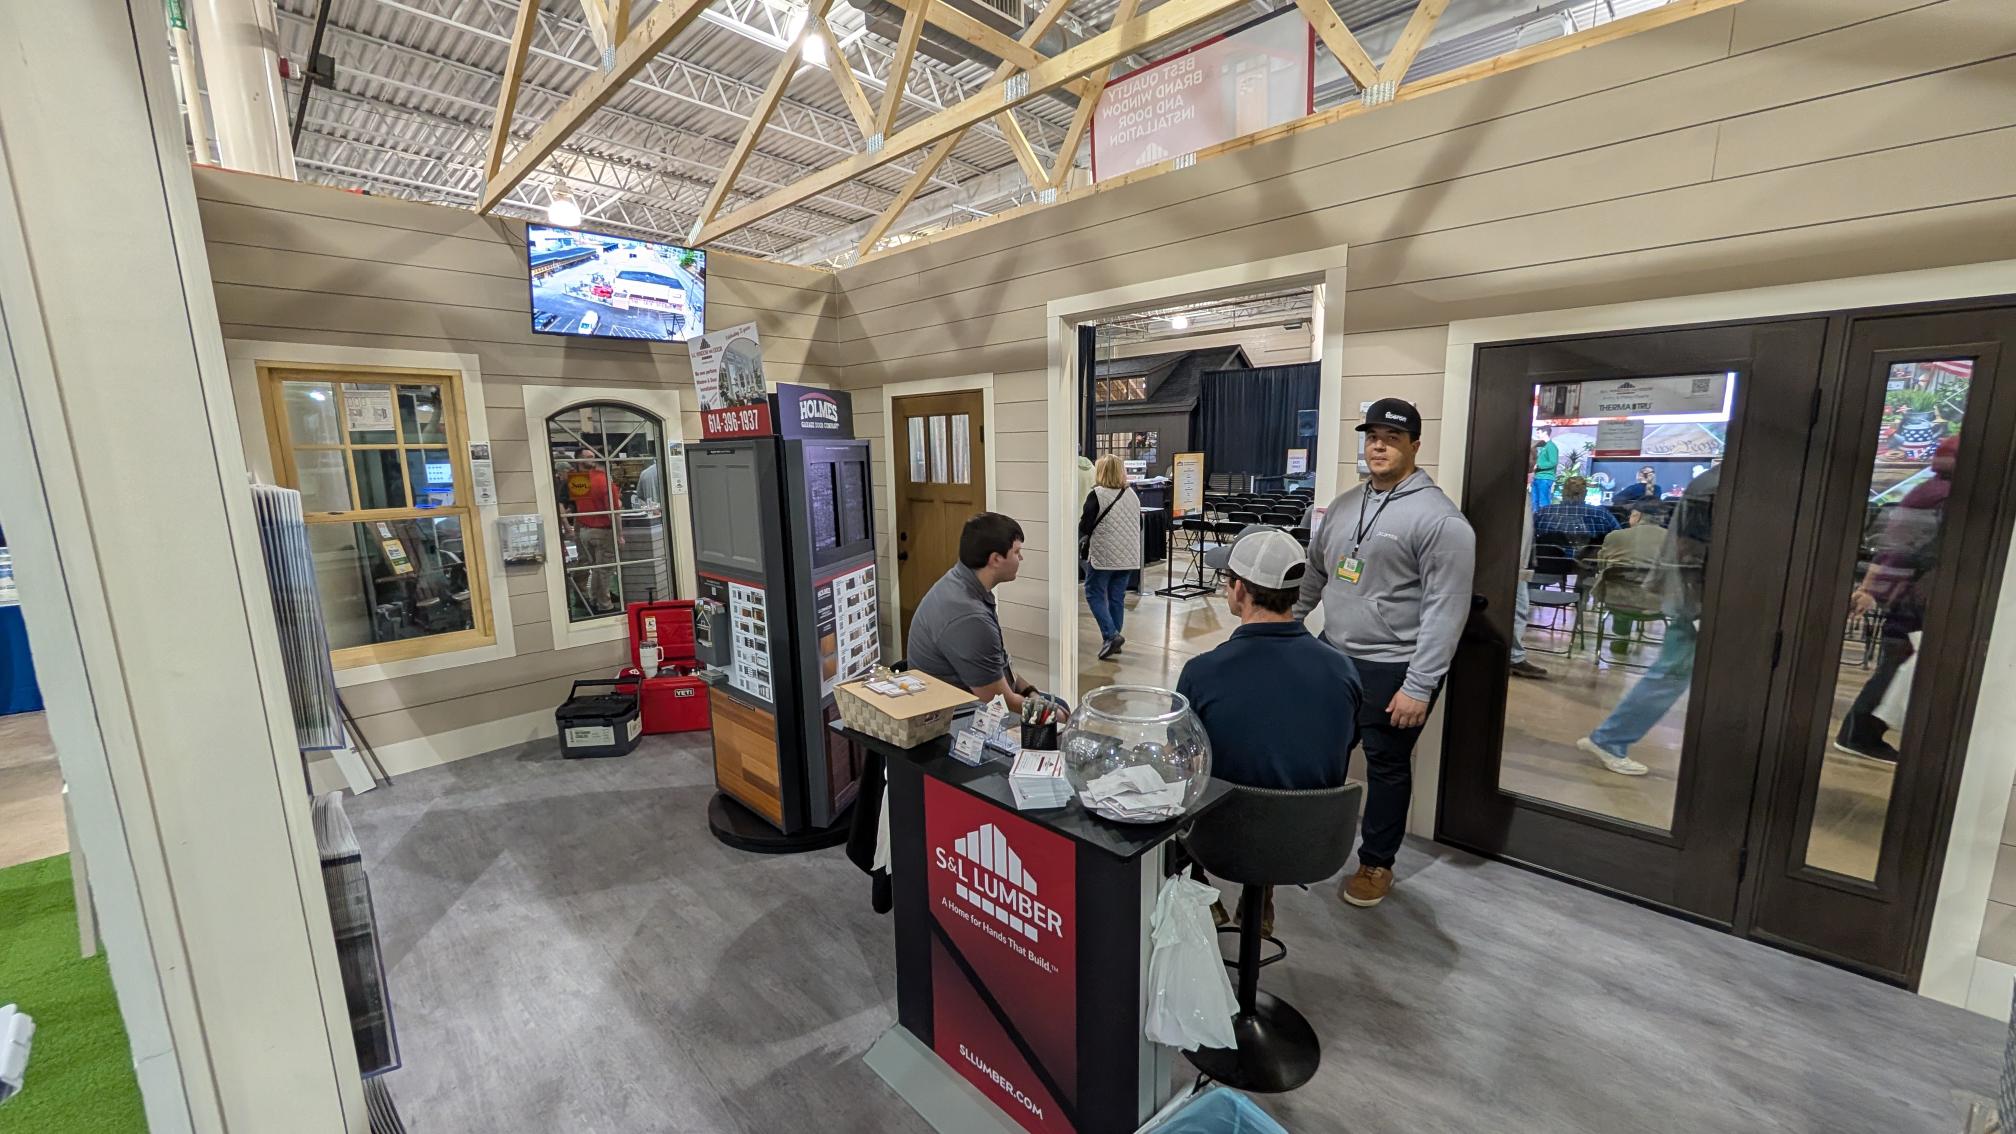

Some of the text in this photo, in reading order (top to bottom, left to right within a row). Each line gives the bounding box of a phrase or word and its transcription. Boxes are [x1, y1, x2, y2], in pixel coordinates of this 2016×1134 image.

[799, 400, 838, 422] HOLMES
[1599, 402, 1652, 412] THERMA TRU
[708, 409, 759, 433] 614-396-1937
[676, 689, 693, 697] YETI
[936, 847, 1063, 938] S&L LUMBER
[941, 897, 948, 907] A
[948, 900, 970, 921] Home
[970, 915, 982, 928] for
[982, 921, 1007, 944] Hands
[1007, 937, 1027, 957] That
[959, 1043, 1044, 1121] SLLUMBER.COM
